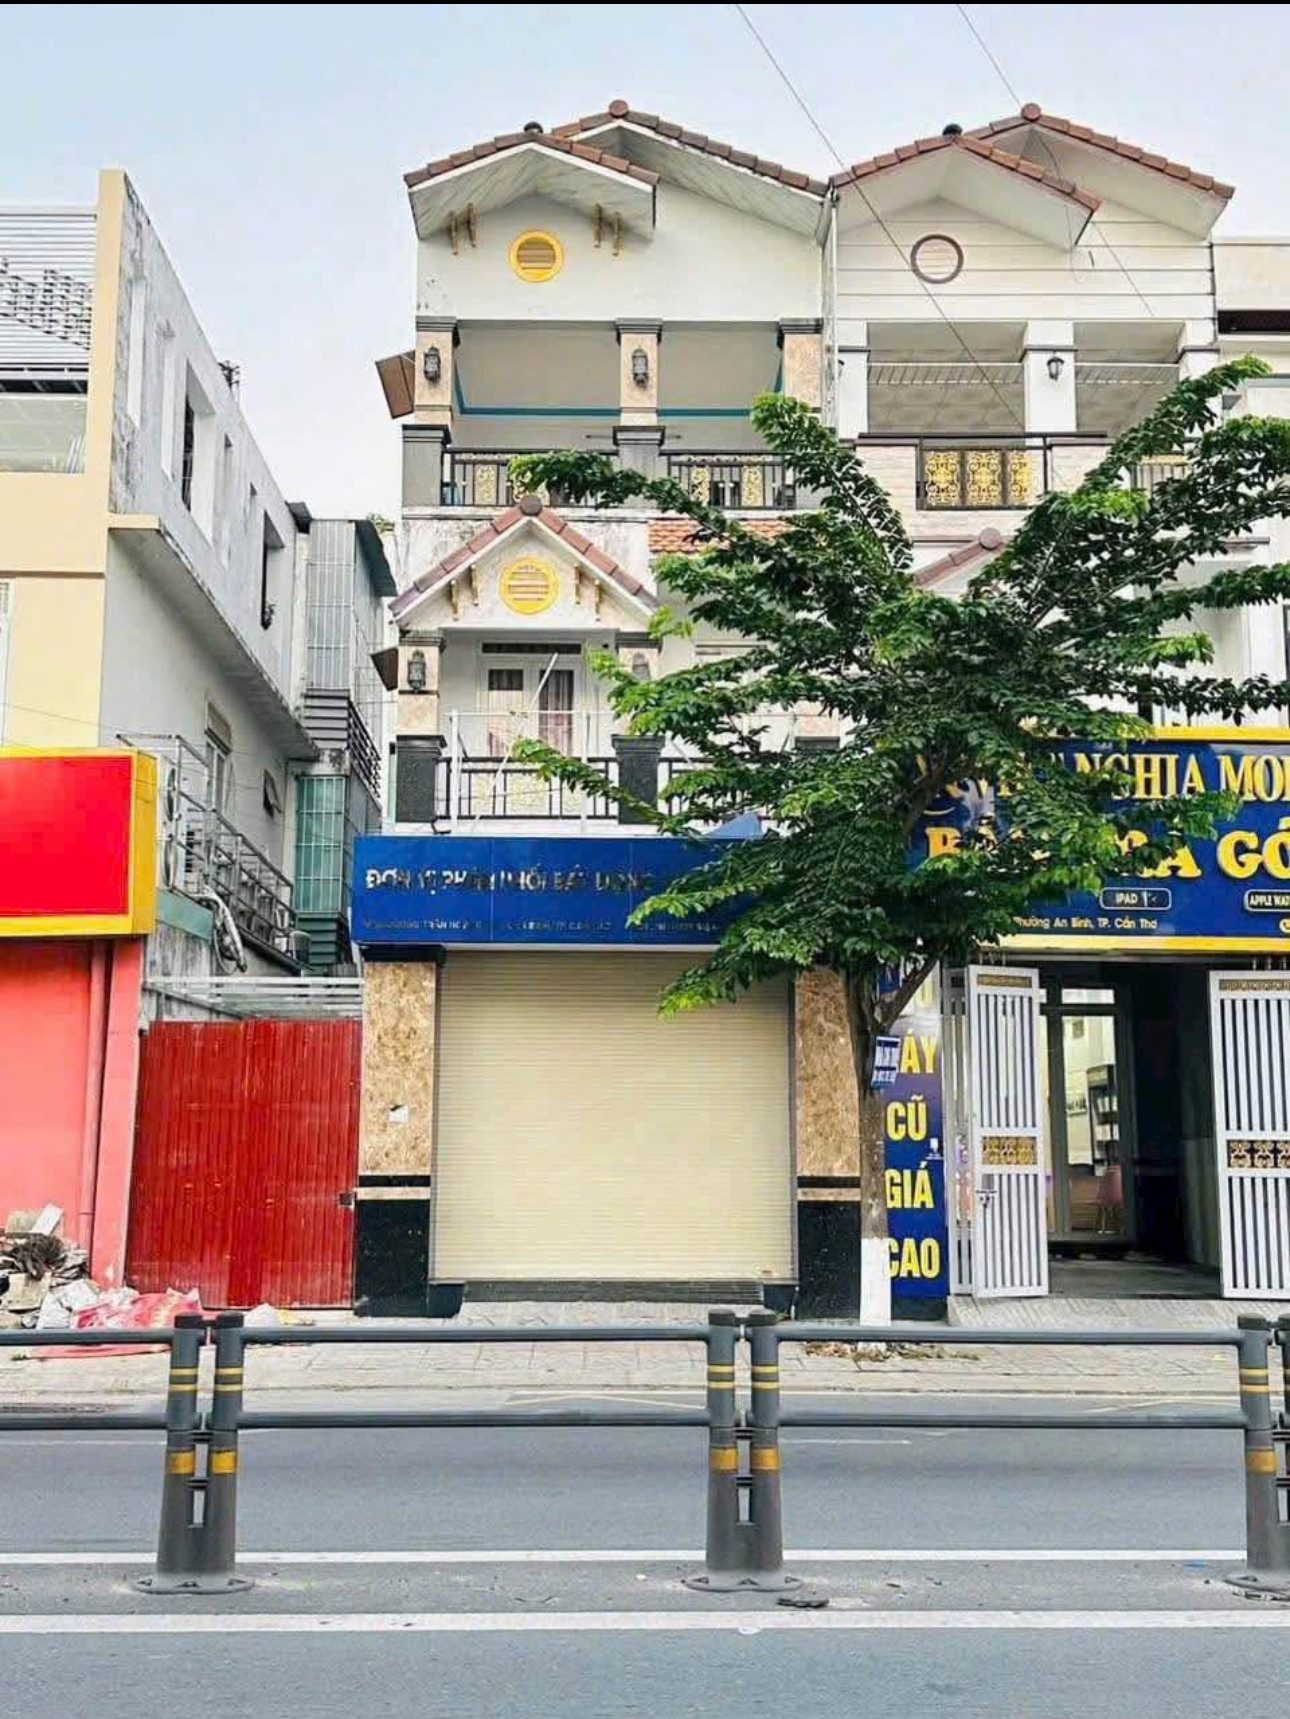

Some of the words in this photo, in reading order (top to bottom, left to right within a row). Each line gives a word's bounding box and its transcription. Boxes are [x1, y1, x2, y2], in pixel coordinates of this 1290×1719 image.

[1216, 753, 1290, 802] MO
[886, 1094, 929, 1142] CŨ
[884, 1160, 935, 1210] GIÁ
[886, 1238, 941, 1280] CAO
